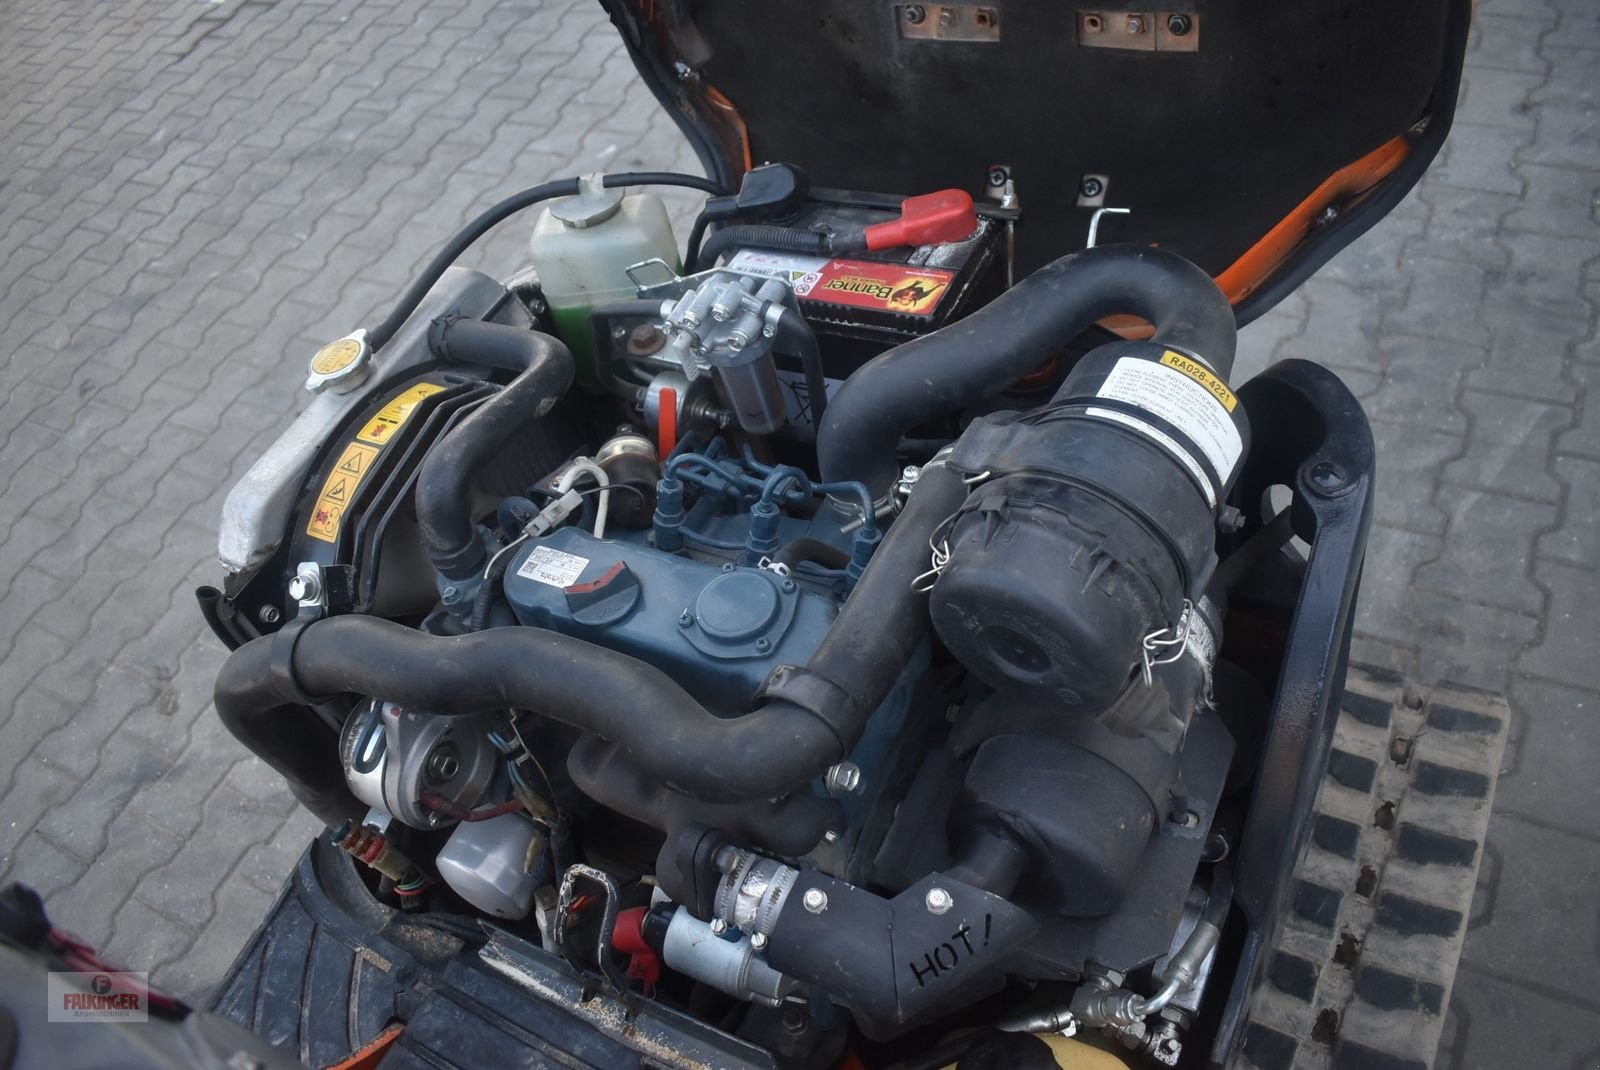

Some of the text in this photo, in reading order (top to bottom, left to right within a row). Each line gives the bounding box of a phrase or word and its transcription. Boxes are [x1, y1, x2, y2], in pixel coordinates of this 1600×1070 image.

[823, 279, 894, 299] Banner
[1164, 372, 1217, 412] INSTRUCTIONS
[1170, 356, 1230, 403] RA028-4221
[909, 913, 992, 987] HOT!
